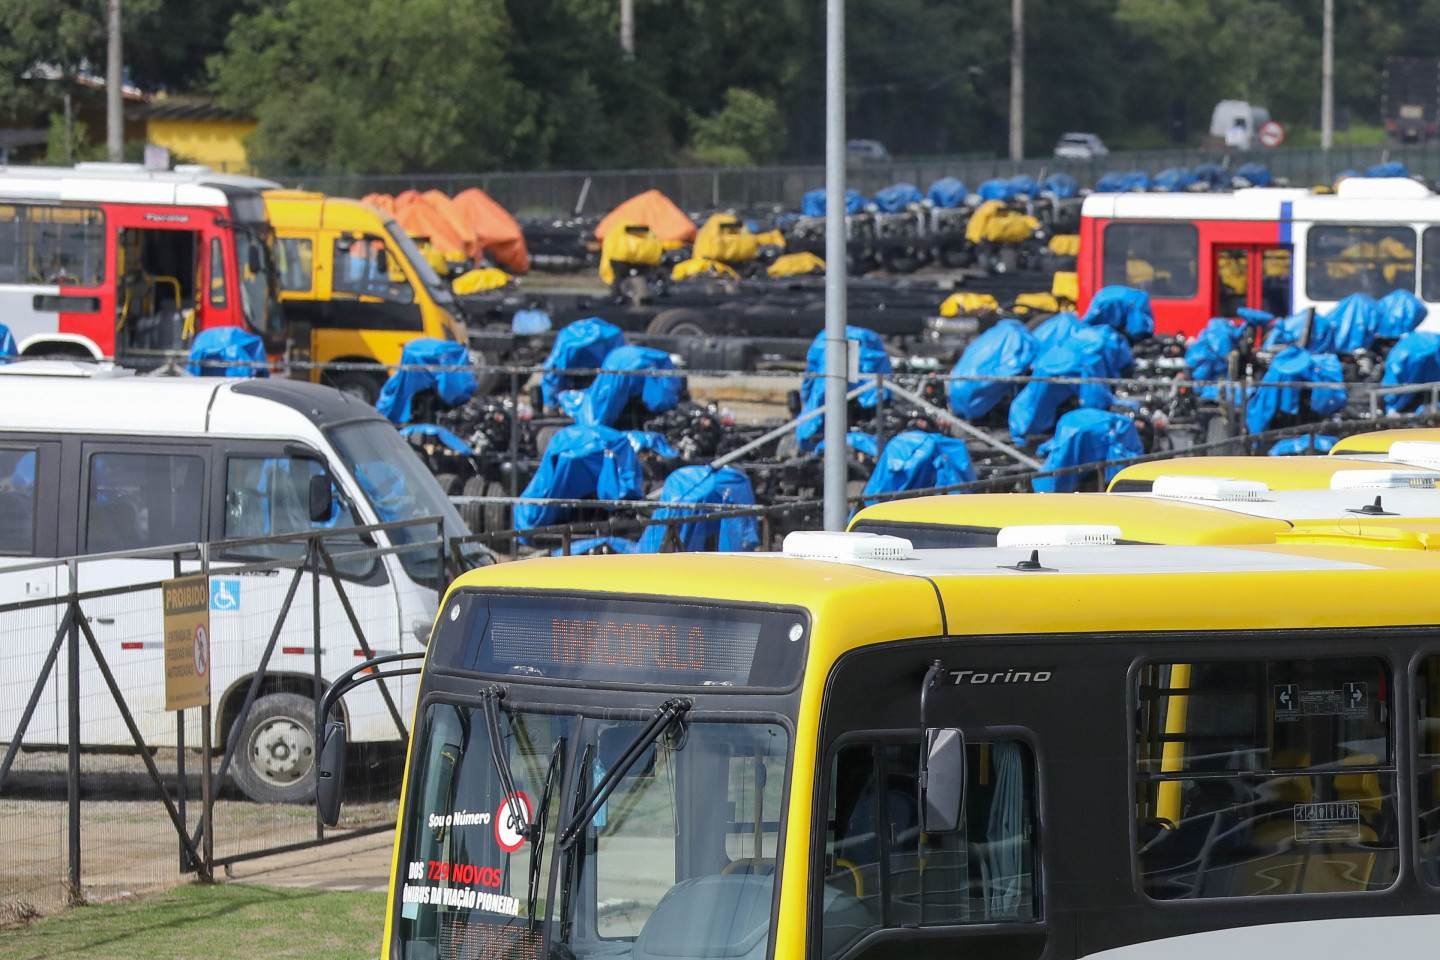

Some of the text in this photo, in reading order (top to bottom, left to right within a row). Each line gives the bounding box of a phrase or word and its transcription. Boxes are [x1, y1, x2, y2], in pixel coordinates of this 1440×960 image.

[166, 585, 206, 609] PROIBIDO
[552, 618, 704, 672] MARCOPOLO
[948, 668, 1053, 686] Torino
[428, 813, 445, 828] Sou
[445, 814, 453, 826] o
[453, 809, 490, 826] Número
[408, 860, 503, 888] DOS 729 NOVOS
[403, 883, 520, 916] ÔNIBUS DA VIAÇÃO PIONEIRA
